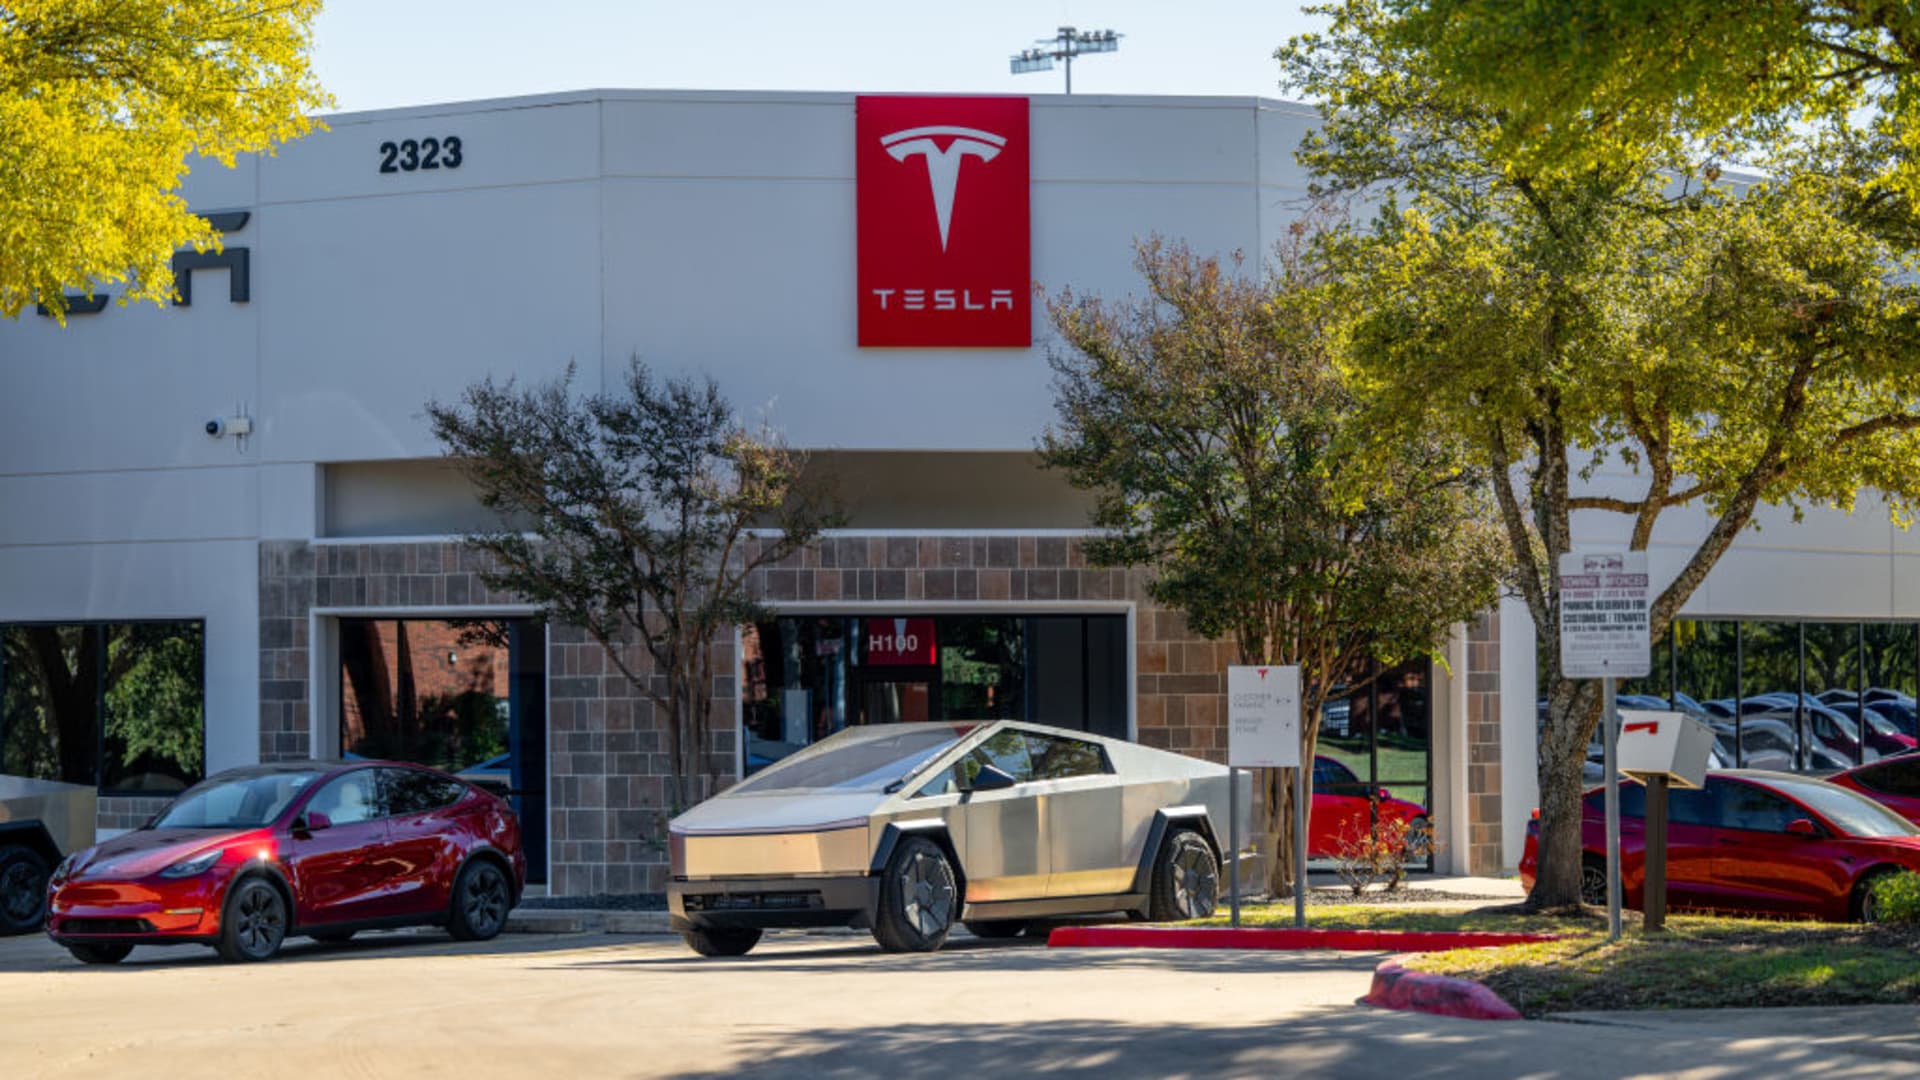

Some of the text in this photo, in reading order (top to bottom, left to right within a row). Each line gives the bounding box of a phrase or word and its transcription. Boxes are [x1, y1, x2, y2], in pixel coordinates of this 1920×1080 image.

[380, 136, 462, 173] 2323
[872, 289, 1012, 310] TESLA
[1563, 601, 1594, 610] PARKING
[1596, 600, 1631, 609] RESERVED
[1563, 614, 1607, 623] CUSTOMERS
[1614, 613, 1646, 622] TENANTS
[869, 634, 918, 652] H100
